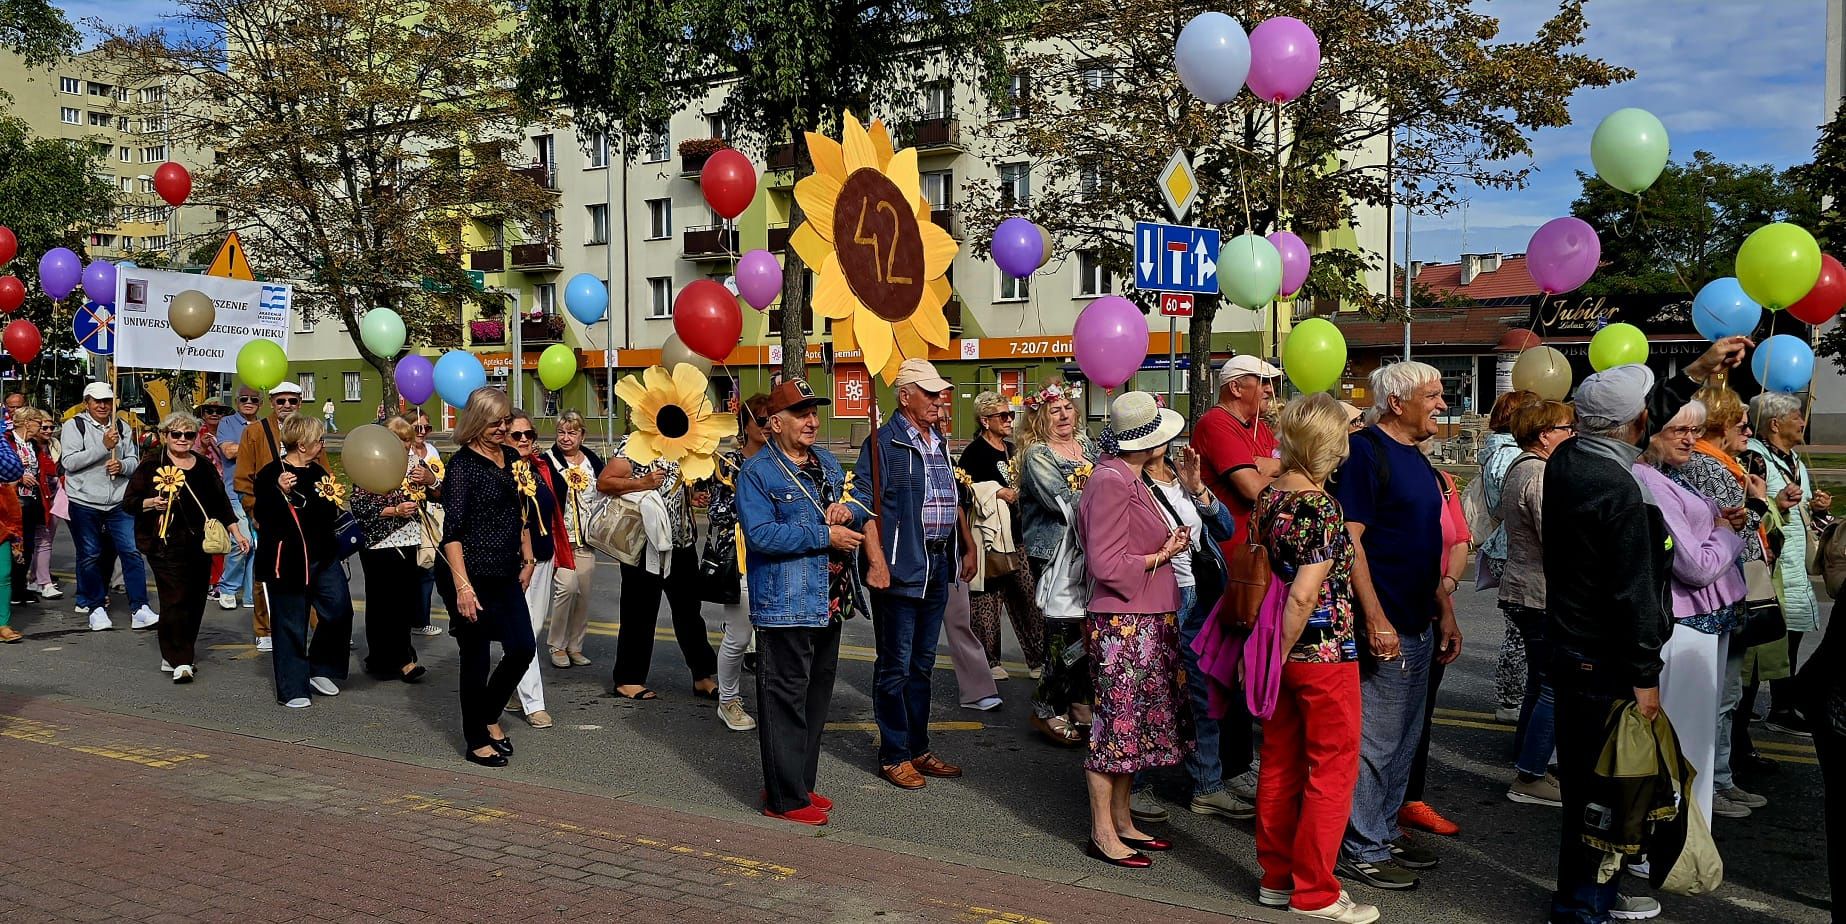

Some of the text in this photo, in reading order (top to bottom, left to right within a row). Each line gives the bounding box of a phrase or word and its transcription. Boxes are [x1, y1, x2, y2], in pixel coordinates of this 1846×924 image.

[854, 196, 913, 285] 42
[163, 294, 249, 311] STSZENIE
[1166, 297, 1178, 312] 60
[1543, 297, 1619, 326] Jubiler
[123, 316, 284, 338] UNIWERSY ZECIEGO WIEKU
[176, 346, 225, 359] W PŁOCKU
[1009, 339, 1073, 355] 7-20/7 dni
[1650, 345, 1700, 355] LUBNE
[804, 350, 822, 361] Apte
